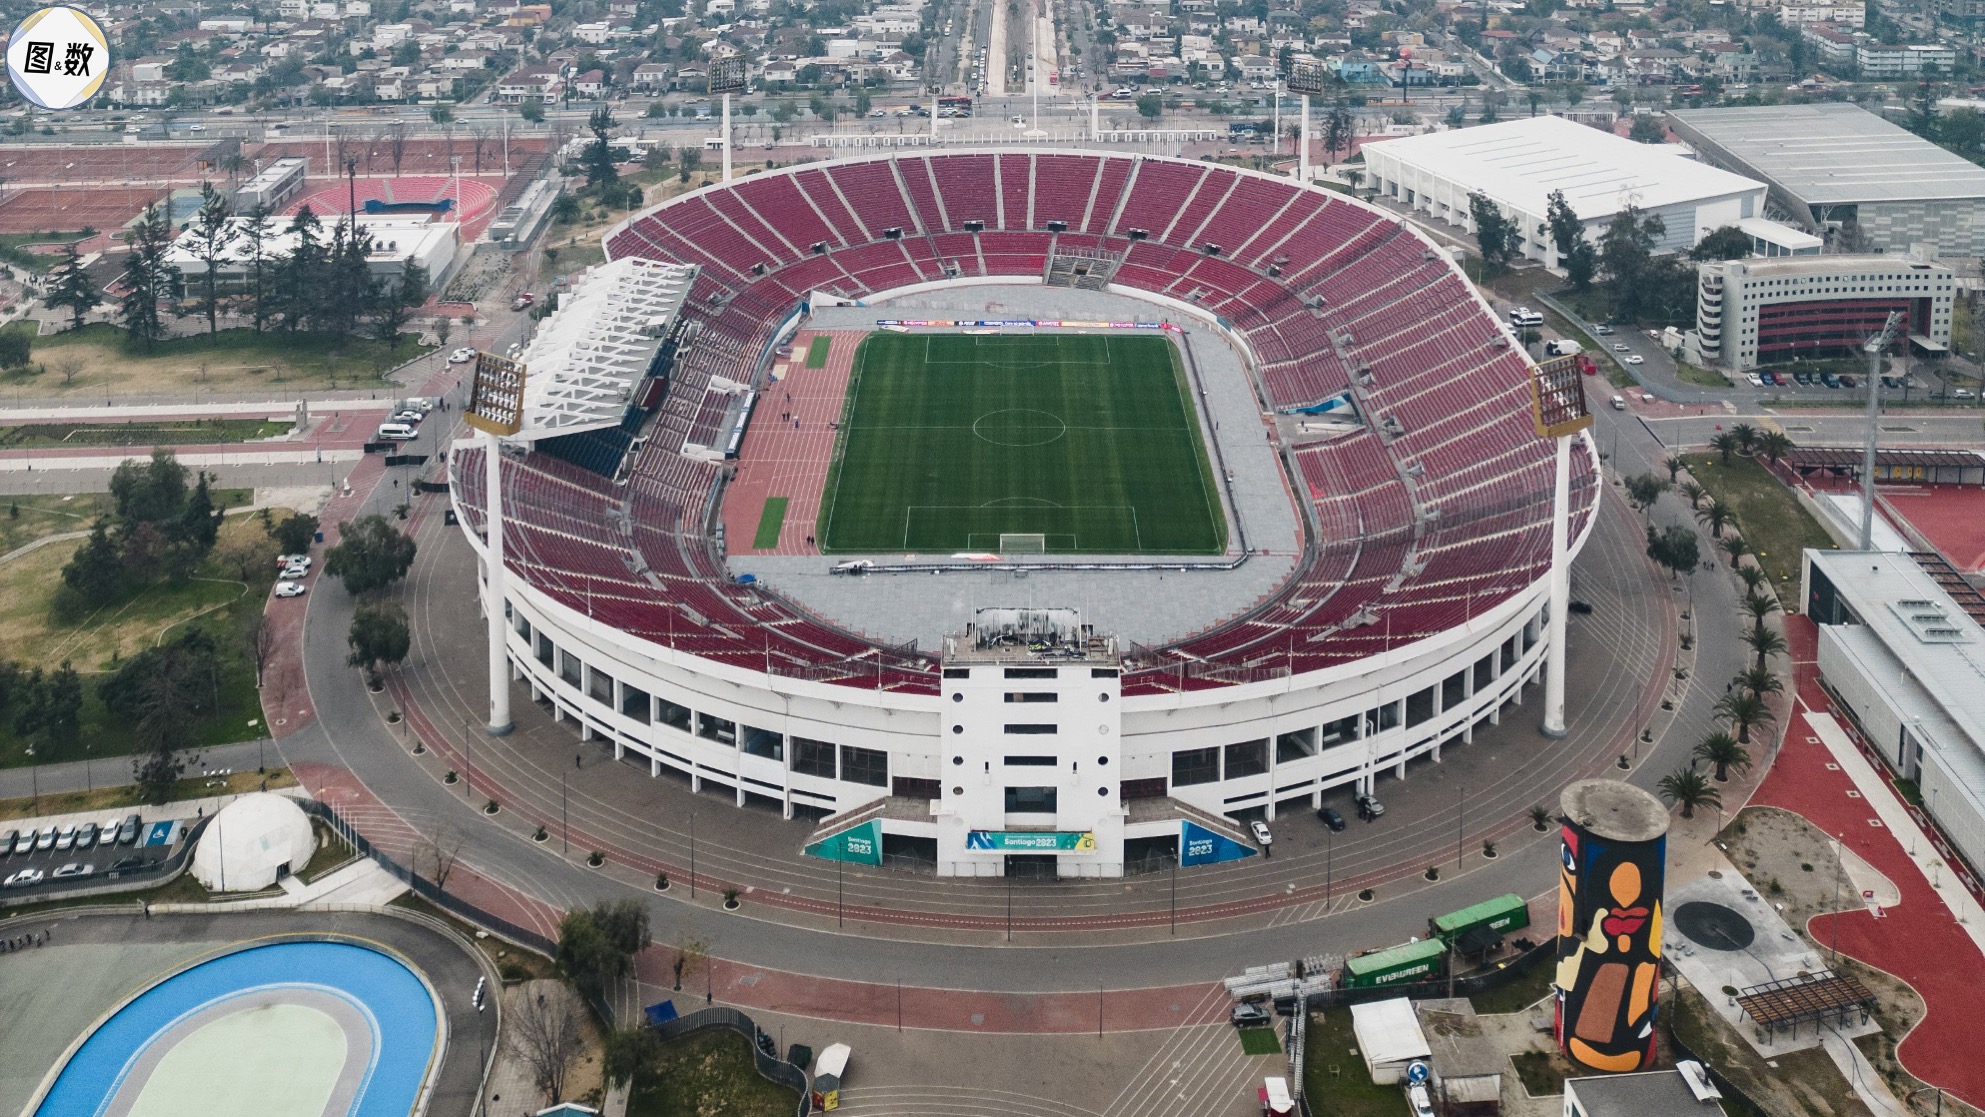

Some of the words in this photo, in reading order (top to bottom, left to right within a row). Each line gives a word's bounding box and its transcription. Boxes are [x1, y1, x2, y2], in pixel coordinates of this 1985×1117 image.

[1005, 838, 1035, 846] Santiago
[1036, 838, 1056, 846] 2023
[848, 843, 871, 854] 2023
[1189, 844, 1212, 856] 2023
[1375, 964, 1429, 985] EVERGREEN
